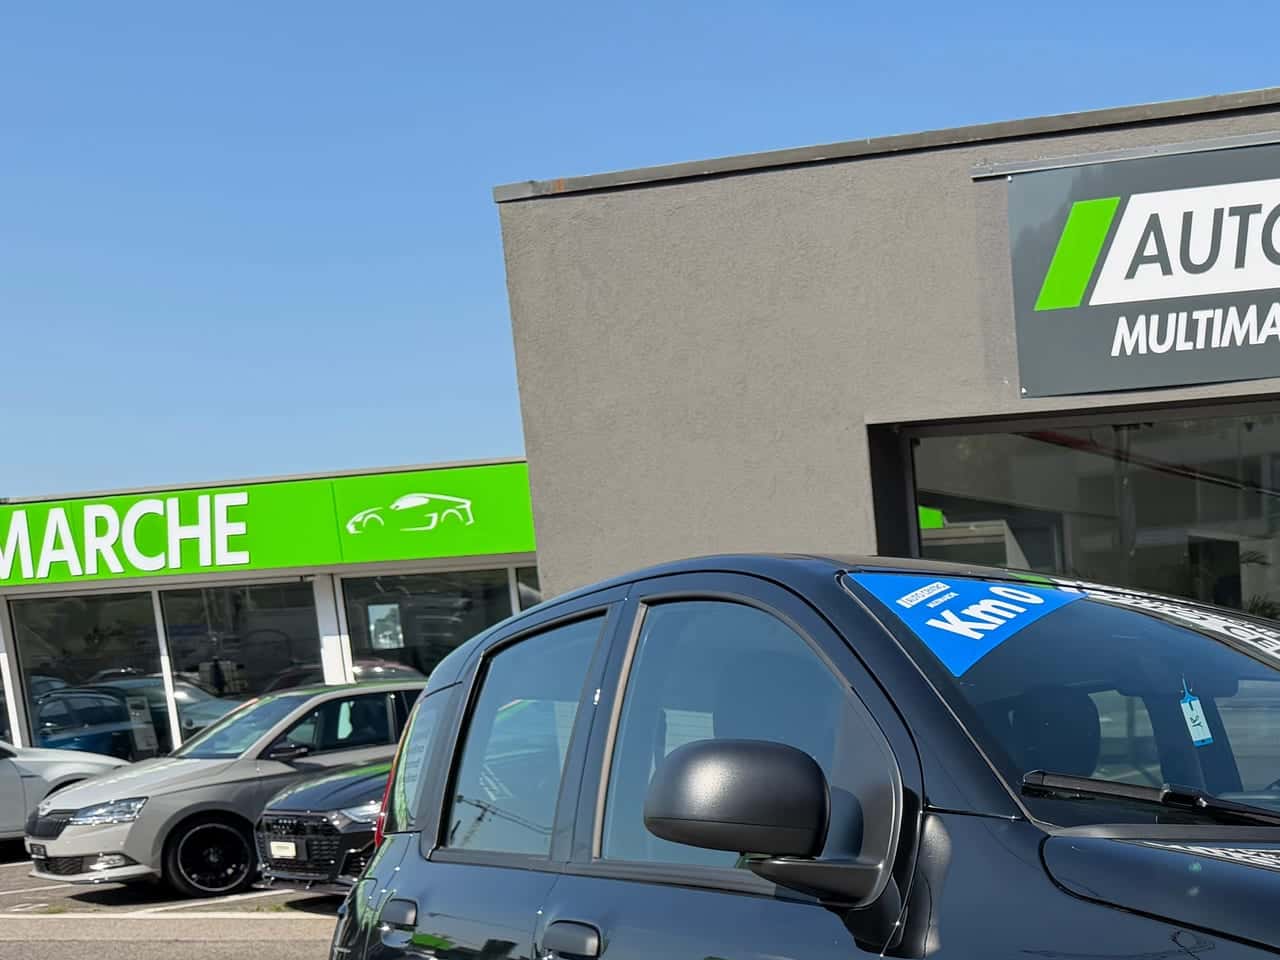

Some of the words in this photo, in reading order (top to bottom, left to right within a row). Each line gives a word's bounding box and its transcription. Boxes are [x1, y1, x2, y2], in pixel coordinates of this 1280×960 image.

[0, 492, 250, 580] MARCHE
[925, 599, 1027, 640] Km
[988, 586, 1045, 604] 0
